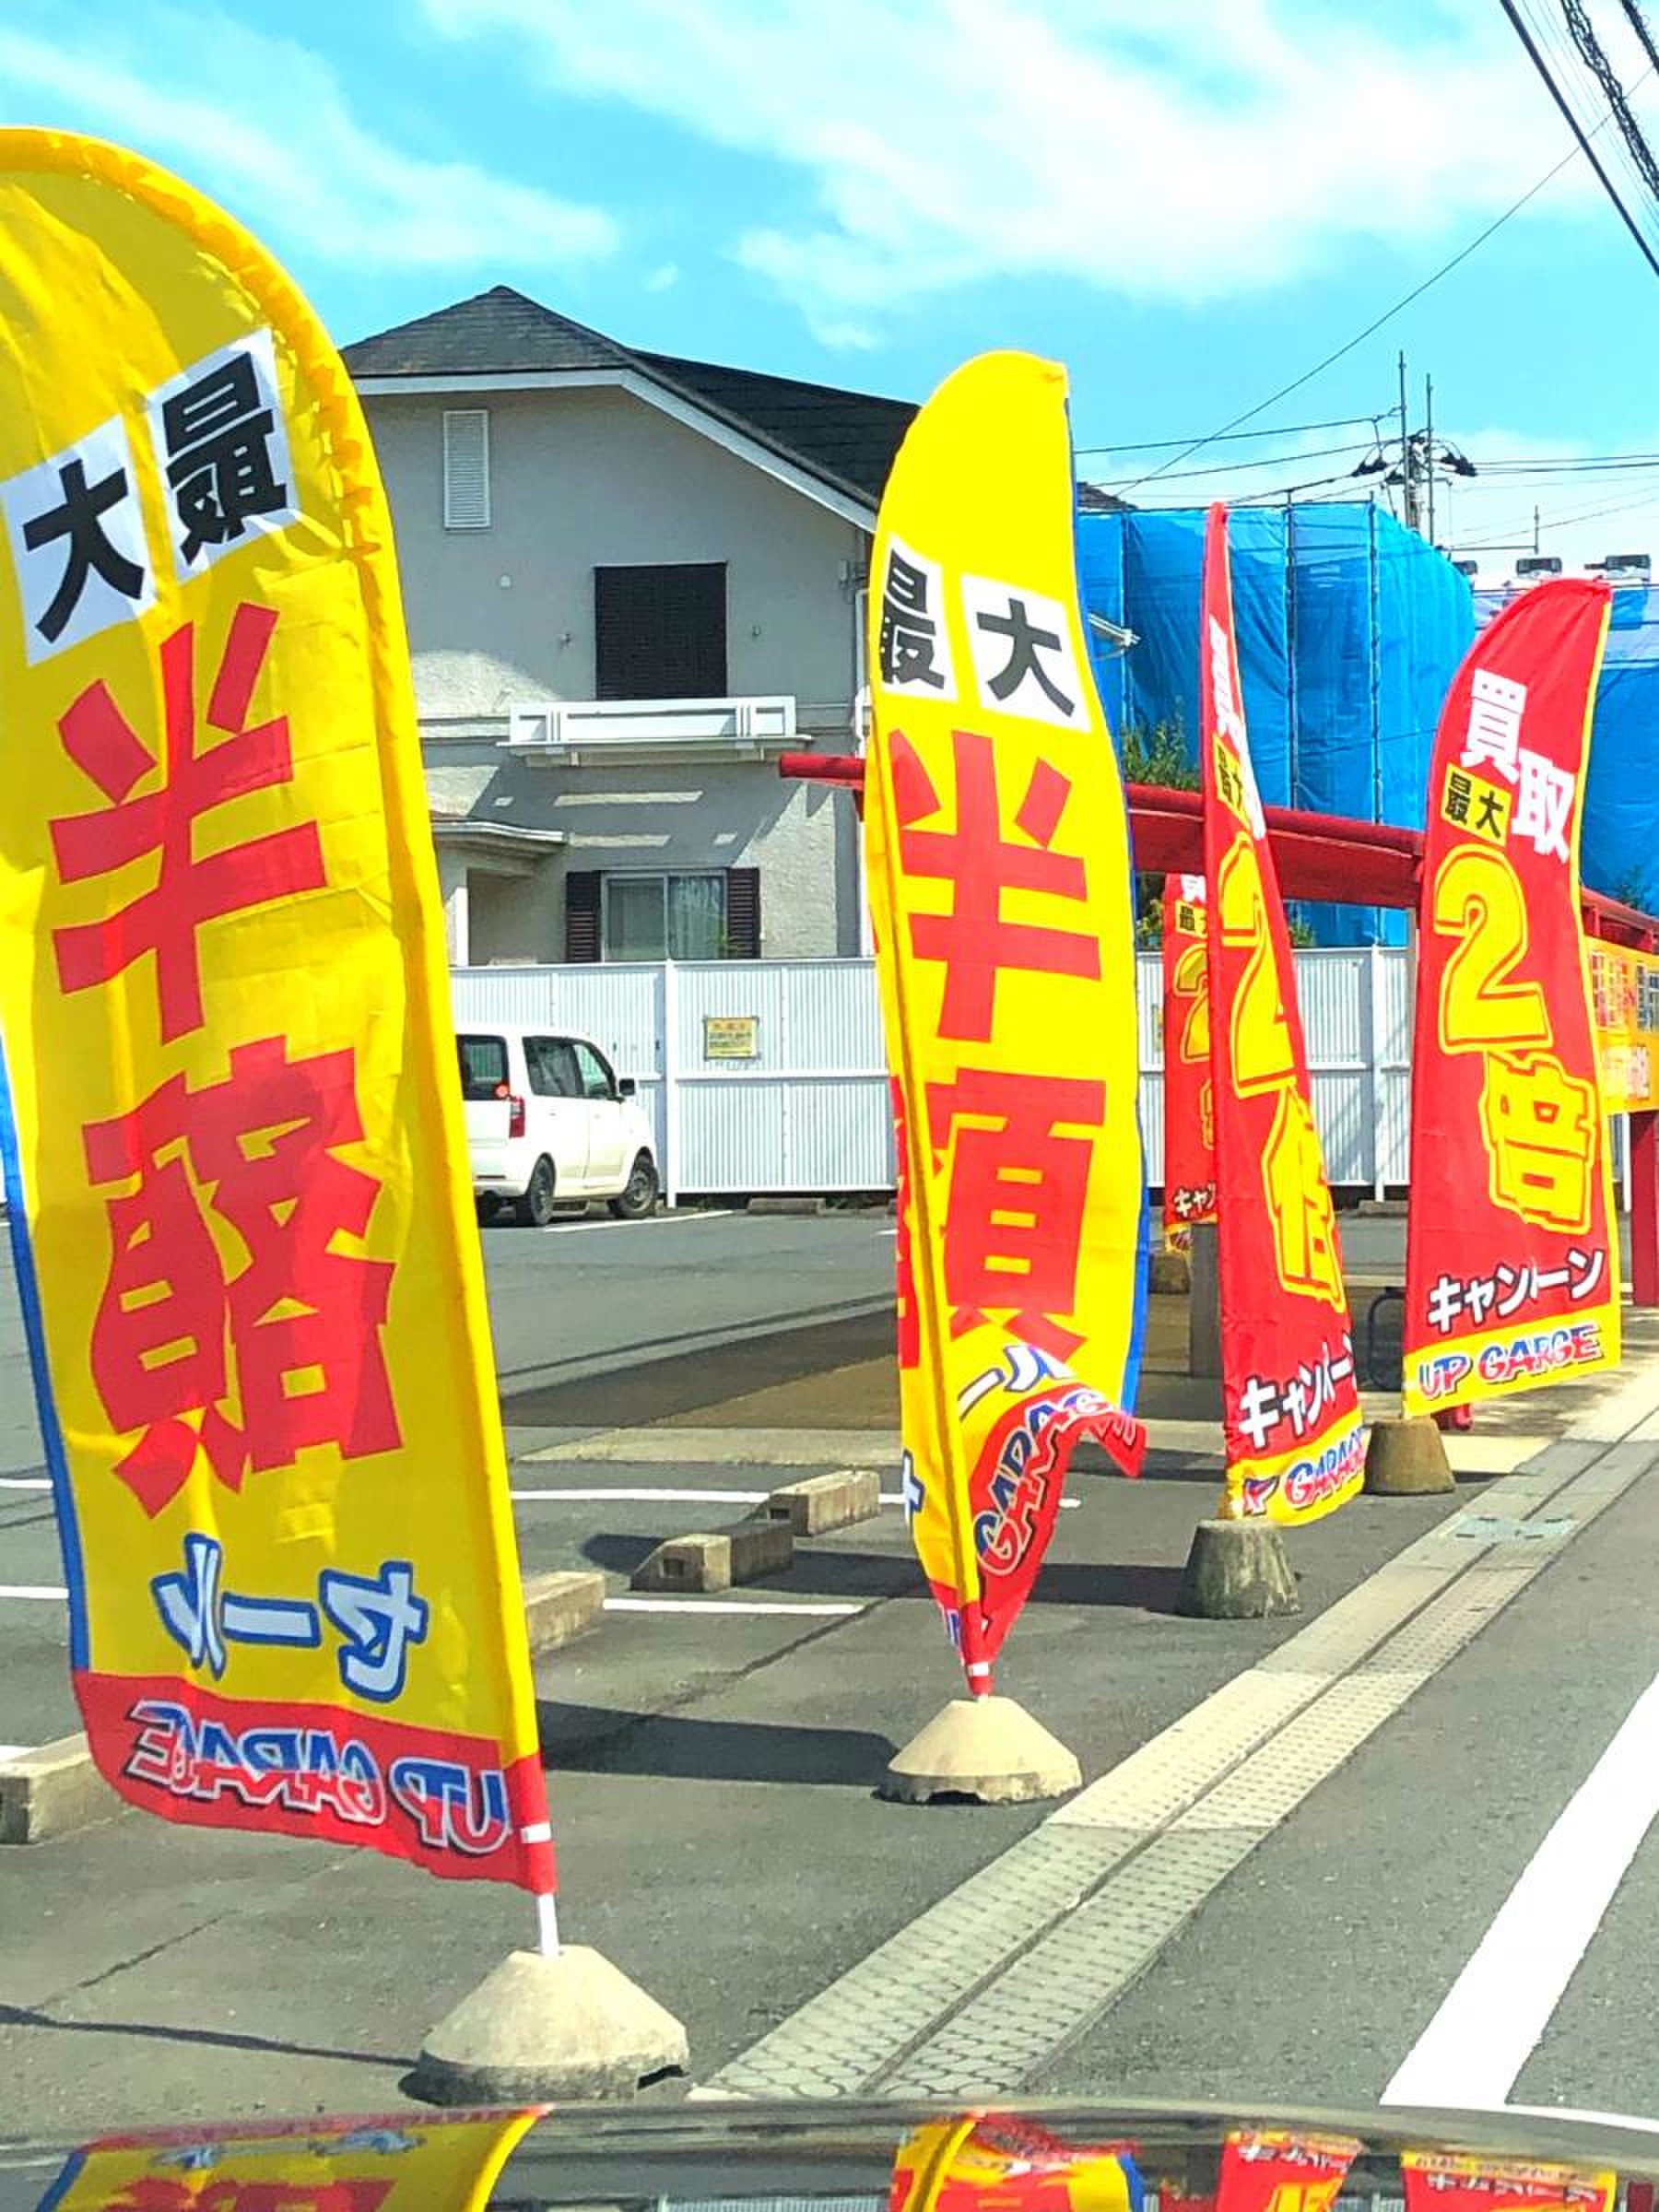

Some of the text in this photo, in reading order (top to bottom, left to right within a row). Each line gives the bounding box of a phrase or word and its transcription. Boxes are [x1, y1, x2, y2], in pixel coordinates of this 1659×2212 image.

[878, 547, 1077, 718] 最大
[1445, 771, 1506, 840] 最大
[1460, 668, 1576, 865] 買取
[1428, 1246, 1605, 1335] キャンーン
[1418, 1354, 1473, 1401] UP
